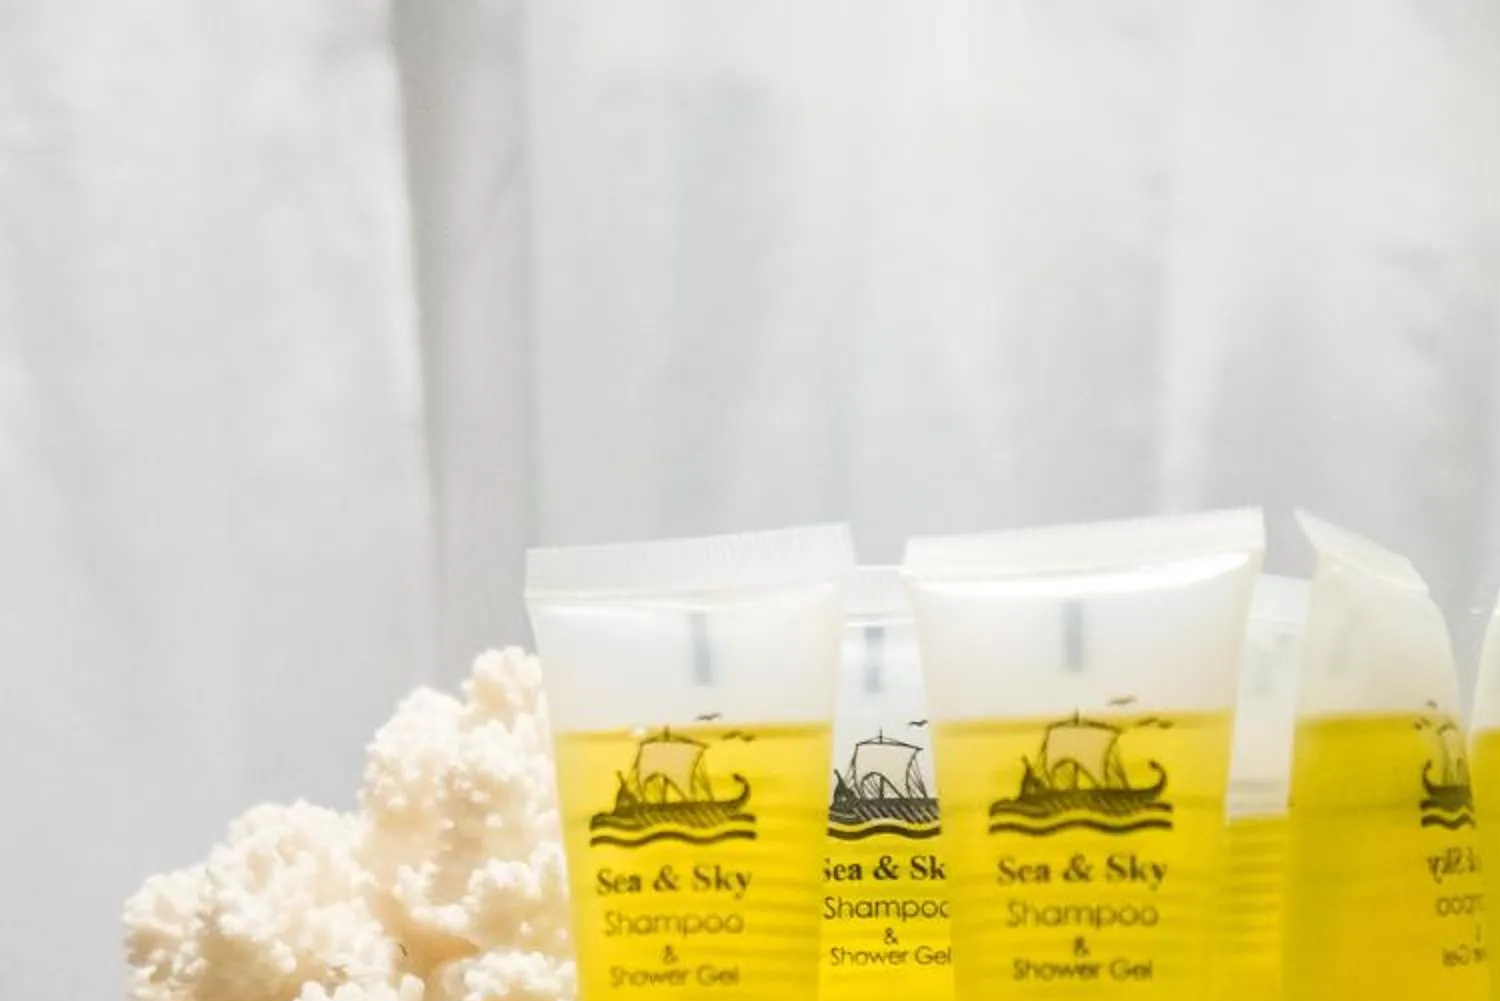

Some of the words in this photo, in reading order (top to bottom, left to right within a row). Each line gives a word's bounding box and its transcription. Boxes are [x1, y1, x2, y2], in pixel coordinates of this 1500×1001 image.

[873, 855, 899, 881] &
[910, 855, 946, 881] Sk
[996, 856, 1049, 887] Sea
[1062, 852, 1093, 882] &
[1105, 853, 1168, 891] Sky
[596, 867, 642, 896] Sea
[652, 864, 679, 892] &
[692, 864, 752, 900] Sky
[604, 909, 744, 938] Shampoo
[1006, 899, 1159, 930] Shampoo
[883, 927, 898, 945] &
[1073, 937, 1089, 957] &
[661, 944, 679, 965] &
[830, 946, 909, 967] Shower
[914, 944, 952, 966] Gel
[609, 964, 690, 989] Shower
[695, 963, 740, 987] Gel
[1012, 957, 1102, 982] Shower
[1108, 957, 1154, 982] Gel
